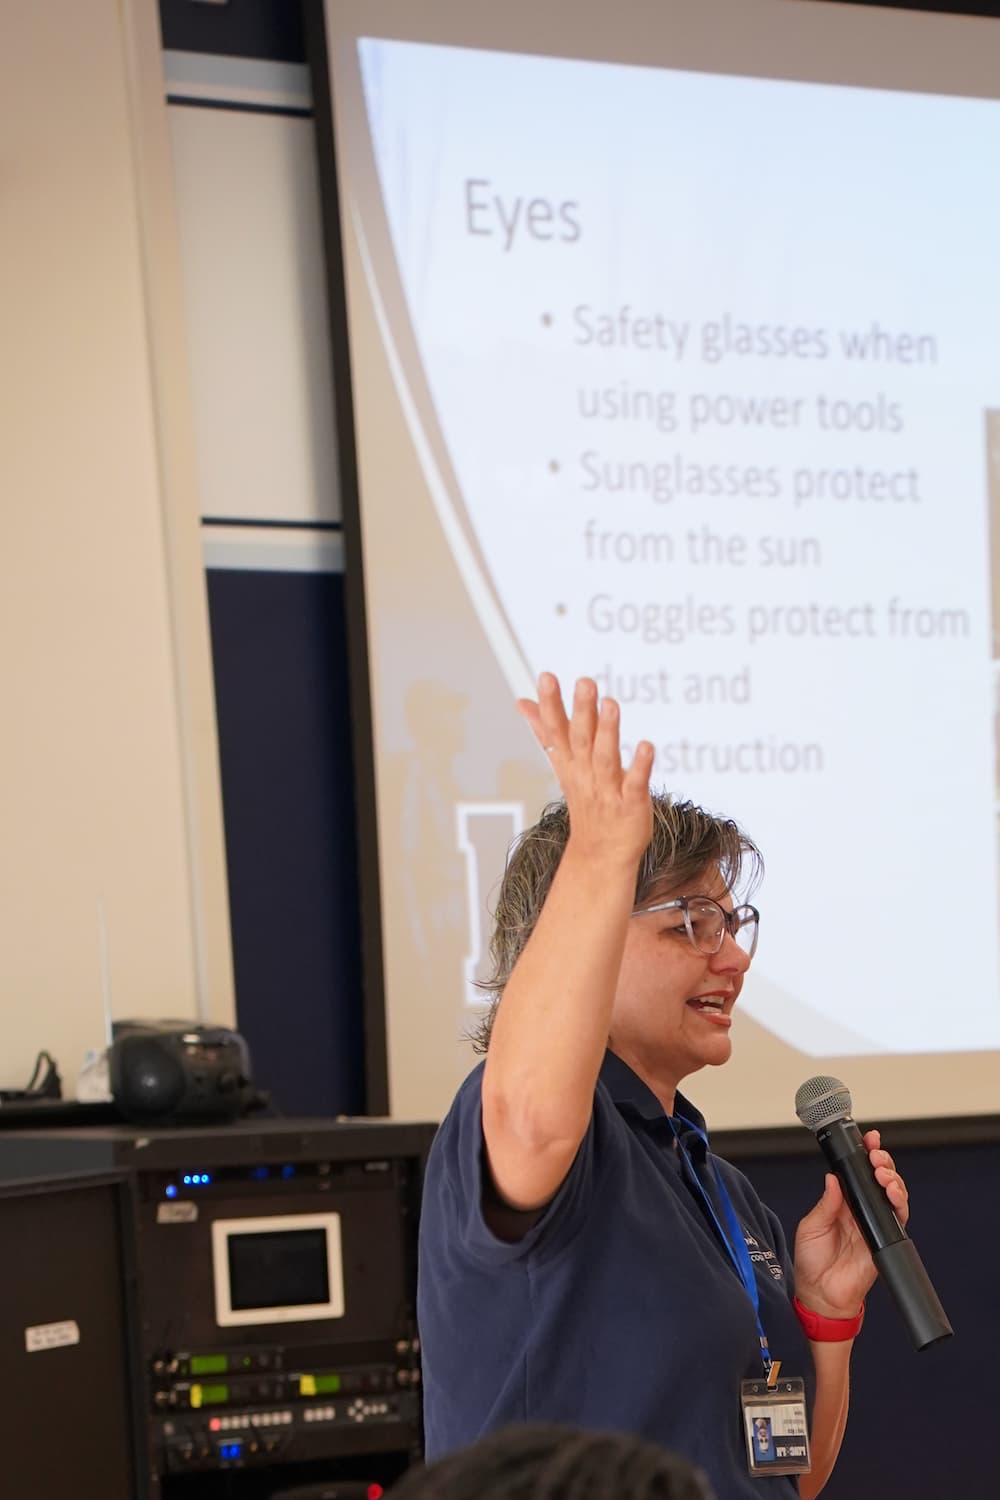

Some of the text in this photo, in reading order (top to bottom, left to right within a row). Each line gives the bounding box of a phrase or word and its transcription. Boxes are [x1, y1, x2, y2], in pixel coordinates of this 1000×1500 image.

[464, 178, 583, 252] Eyes
[573, 304, 938, 364] Safety glasses when
[578, 380, 904, 434] using power tools
[581, 450, 921, 508] Sunglasses protect
[585, 519, 822, 567] from the sun
[587, 593, 971, 645] Goggles protect from
[683, 664, 751, 705] and
